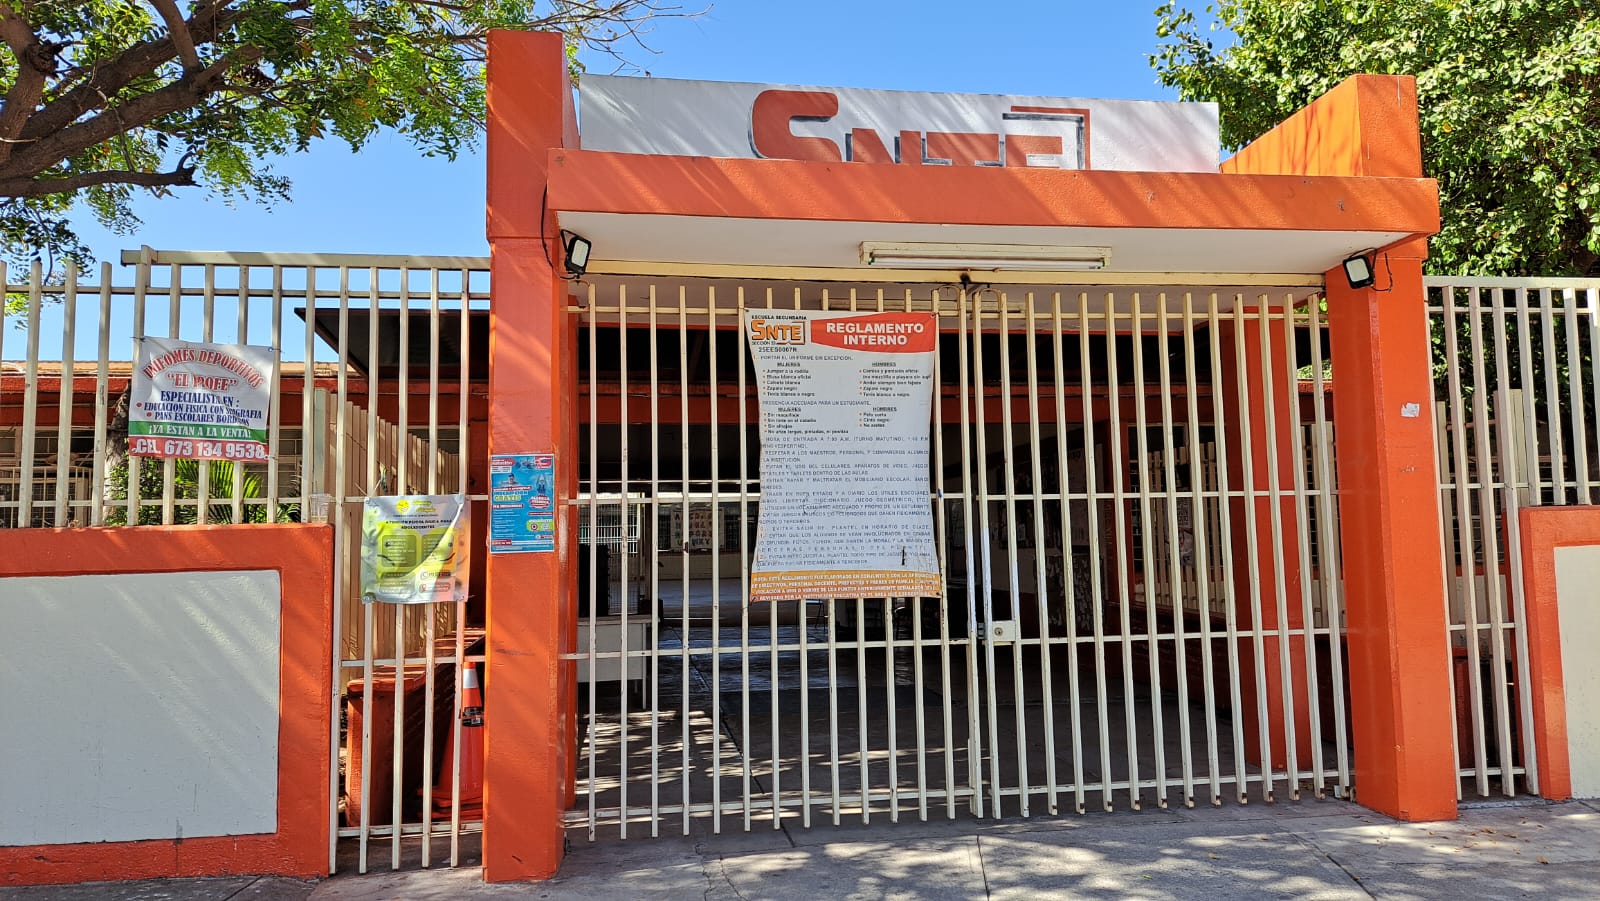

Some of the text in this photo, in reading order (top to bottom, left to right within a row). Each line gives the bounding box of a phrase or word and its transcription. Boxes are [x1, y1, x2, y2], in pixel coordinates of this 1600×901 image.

[751, 320, 801, 341] SNTE
[827, 323, 924, 333] REGLAMENTO
[843, 335, 907, 345] INTERNO
[142, 349, 265, 389] UNIFOMES DEPORTIVOS
[144, 402, 184, 413] EDUCACION
[186, 404, 208, 414] FISICA
[210, 405, 224, 415] CON
[155, 411, 172, 420] PANS
[174, 412, 214, 423] ESCOLARES
[148, 425, 251, 439] ¡YA ESTAN A LA VENTA!
[164, 440, 193, 456] 673
[196, 442, 222, 457] 134
